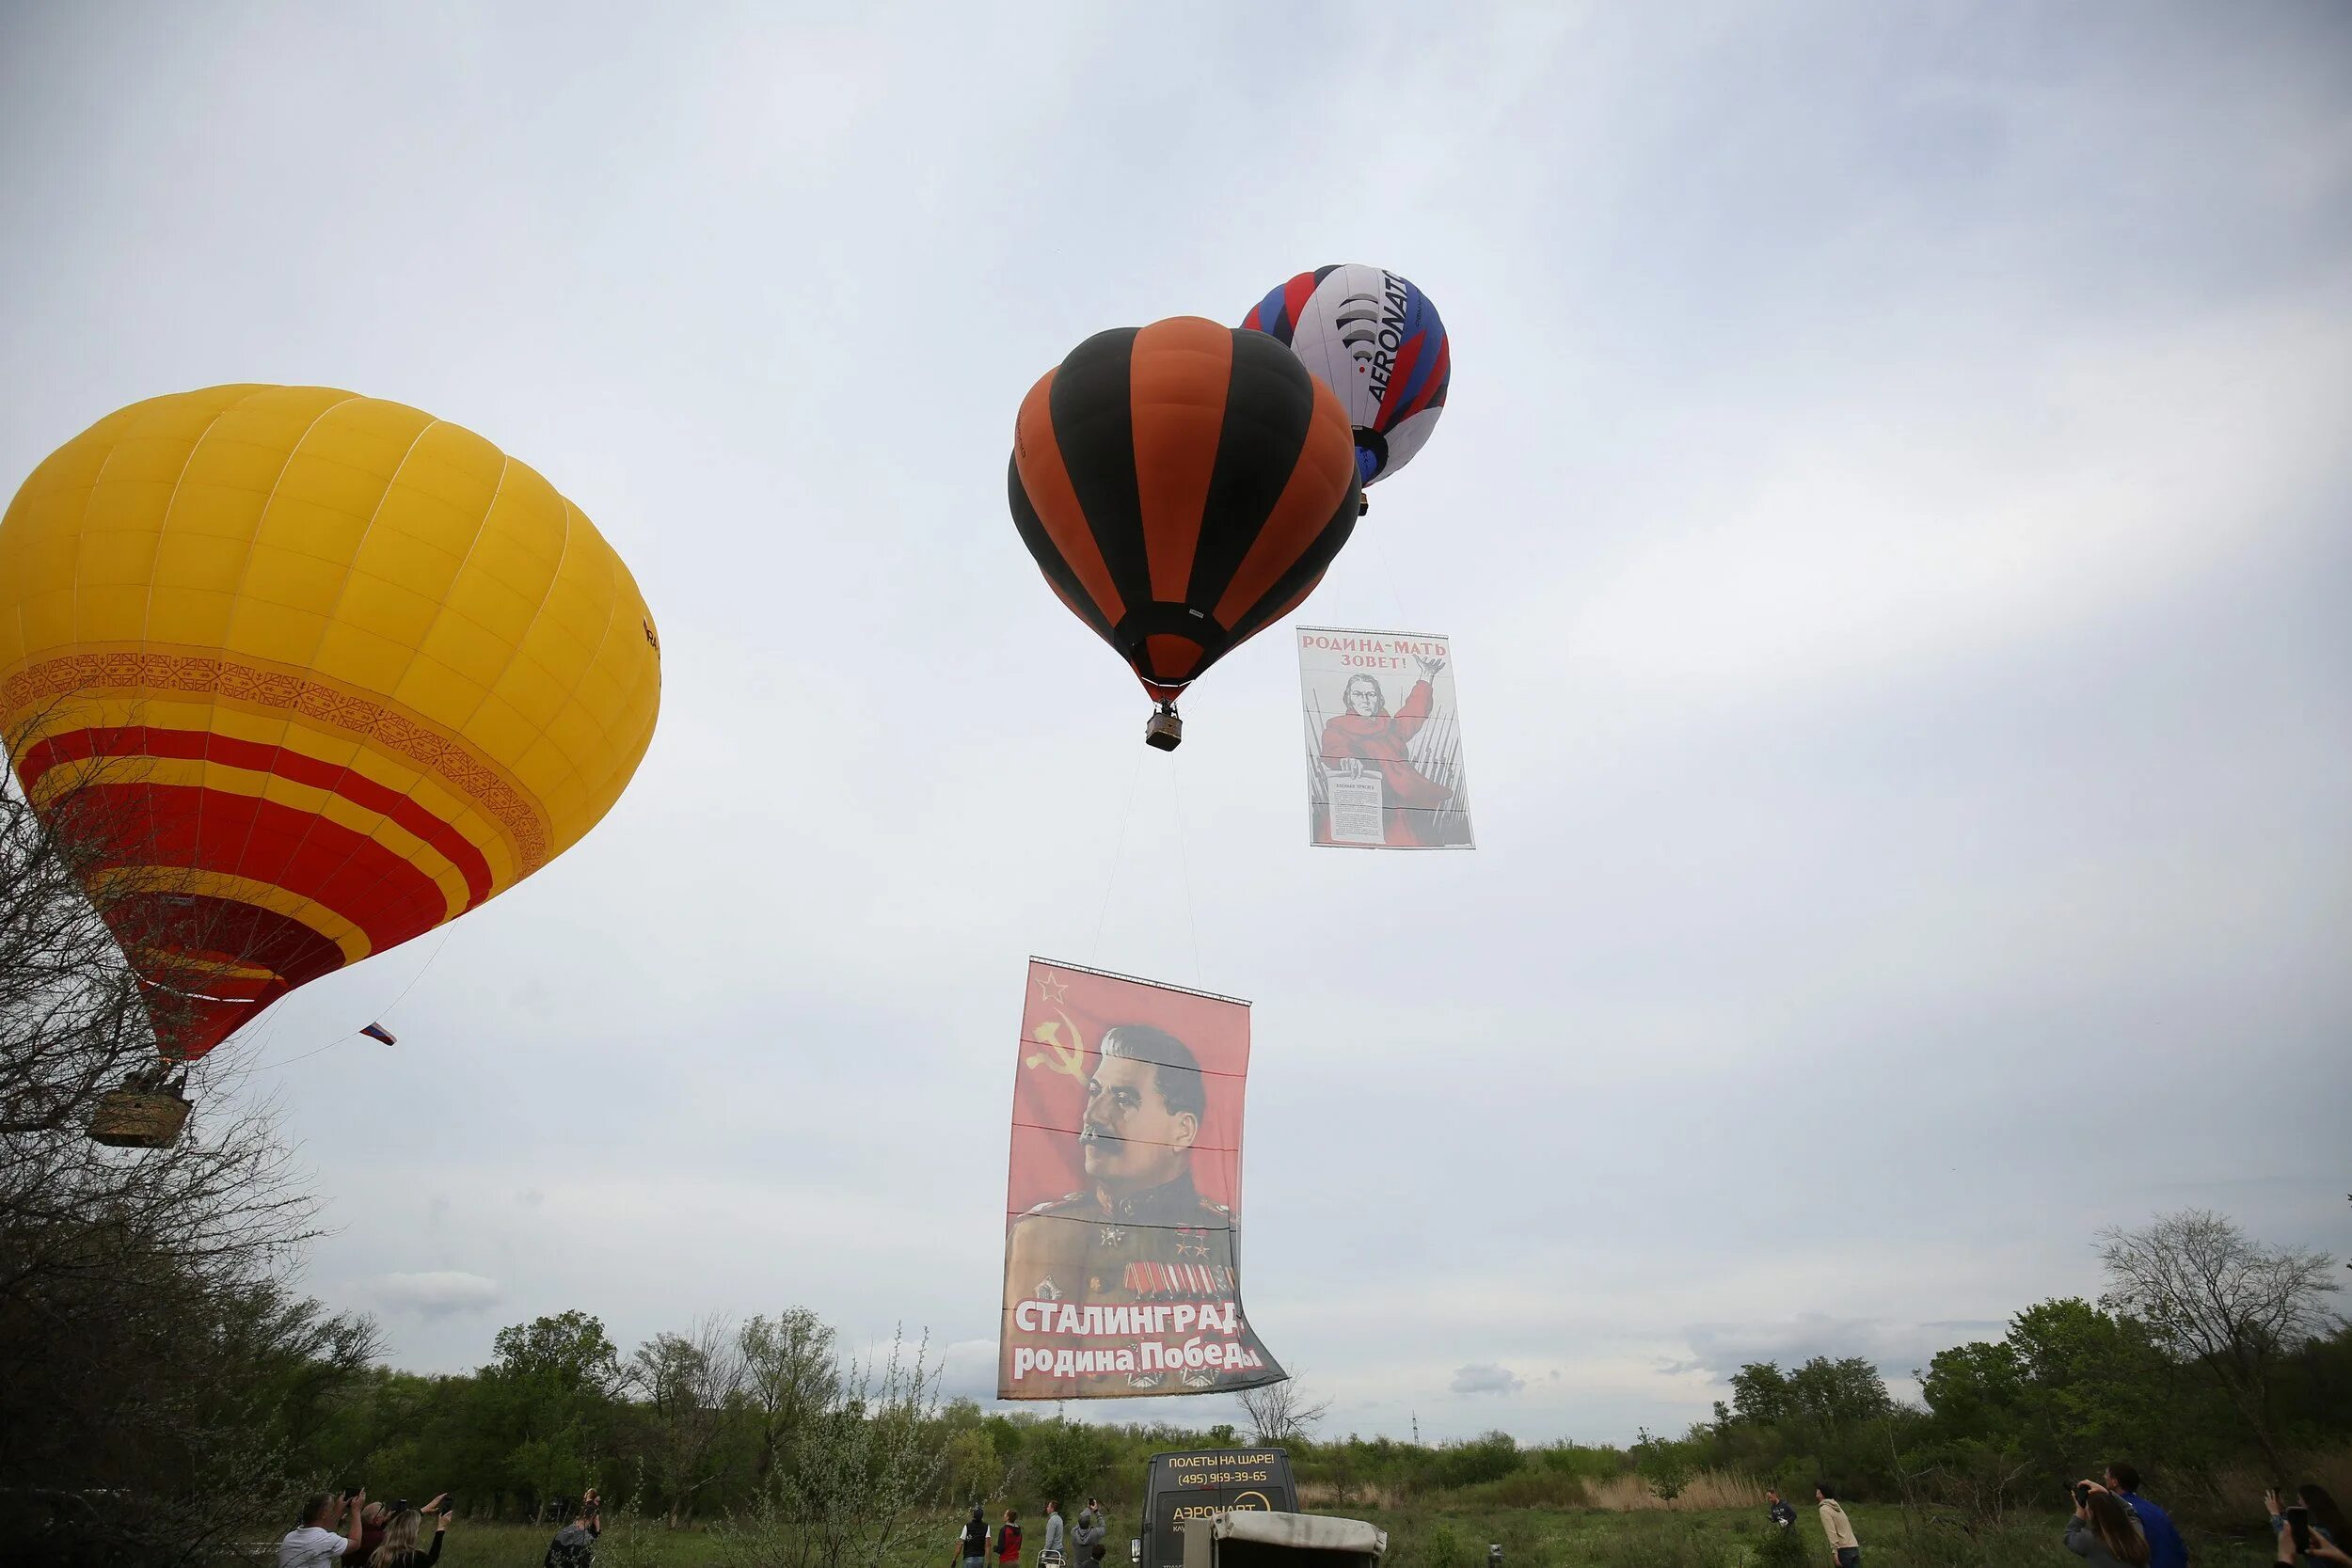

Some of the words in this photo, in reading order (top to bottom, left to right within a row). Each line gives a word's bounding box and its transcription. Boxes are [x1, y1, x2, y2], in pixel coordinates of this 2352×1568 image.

[1302, 635, 1446, 657] РОДИНА-МАТЬ
[1341, 654, 1406, 670] ЗОВЕТ!
[1013, 1347, 1136, 1380] родина
[1168, 1456, 1217, 1468] ПОЛЕТЫ
[1219, 1455, 1236, 1465] НА
[1238, 1453, 1275, 1465] ШАРЕ!
[1178, 1473, 1208, 1486] (495)
[1210, 1471, 1266, 1483] 969-39-65
